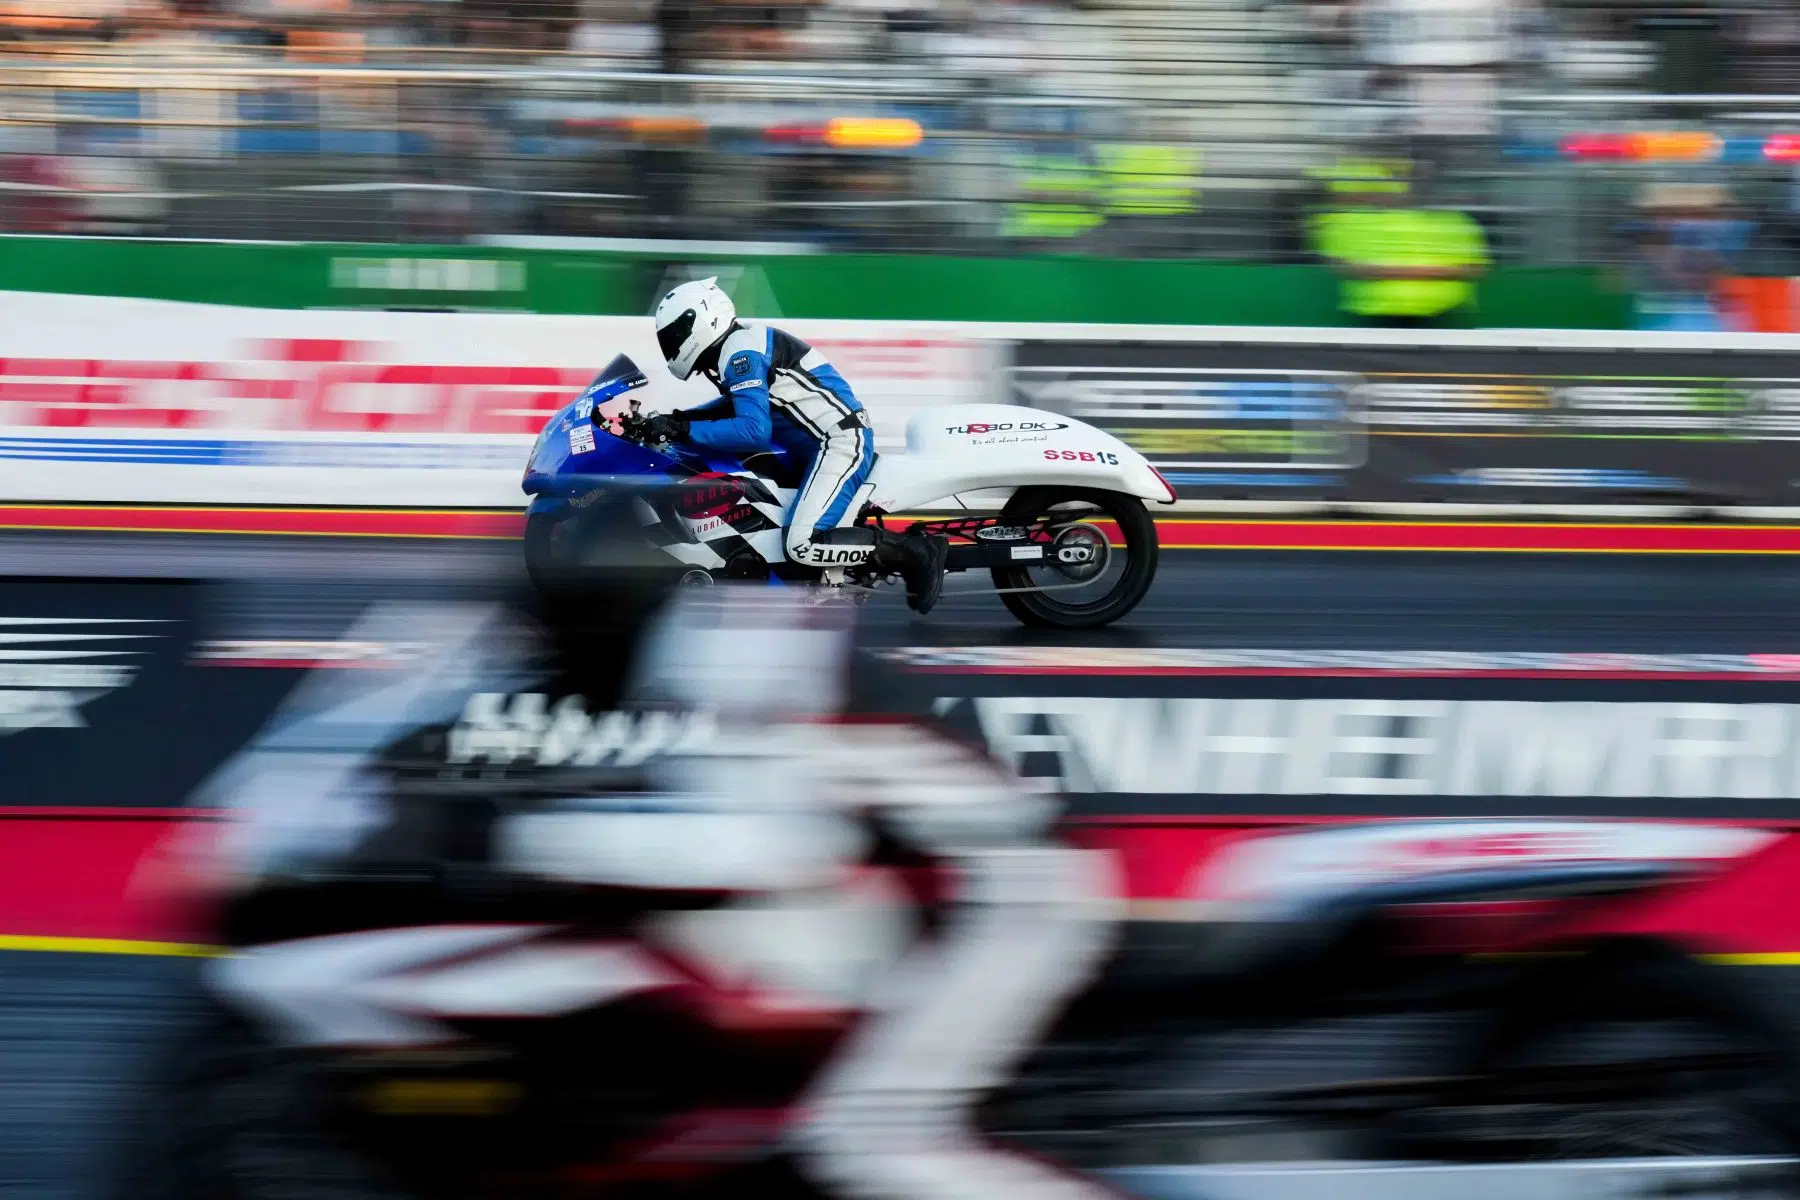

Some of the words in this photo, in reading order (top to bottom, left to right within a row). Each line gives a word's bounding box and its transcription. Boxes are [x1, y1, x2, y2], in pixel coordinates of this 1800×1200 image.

[945, 423, 1013, 435] TURBO
[1019, 422, 1047, 431] DK
[1043, 449, 1119, 466] SSB15
[691, 507, 752, 535] LUBRICANTS
[811, 548, 873, 563] ROUTE
